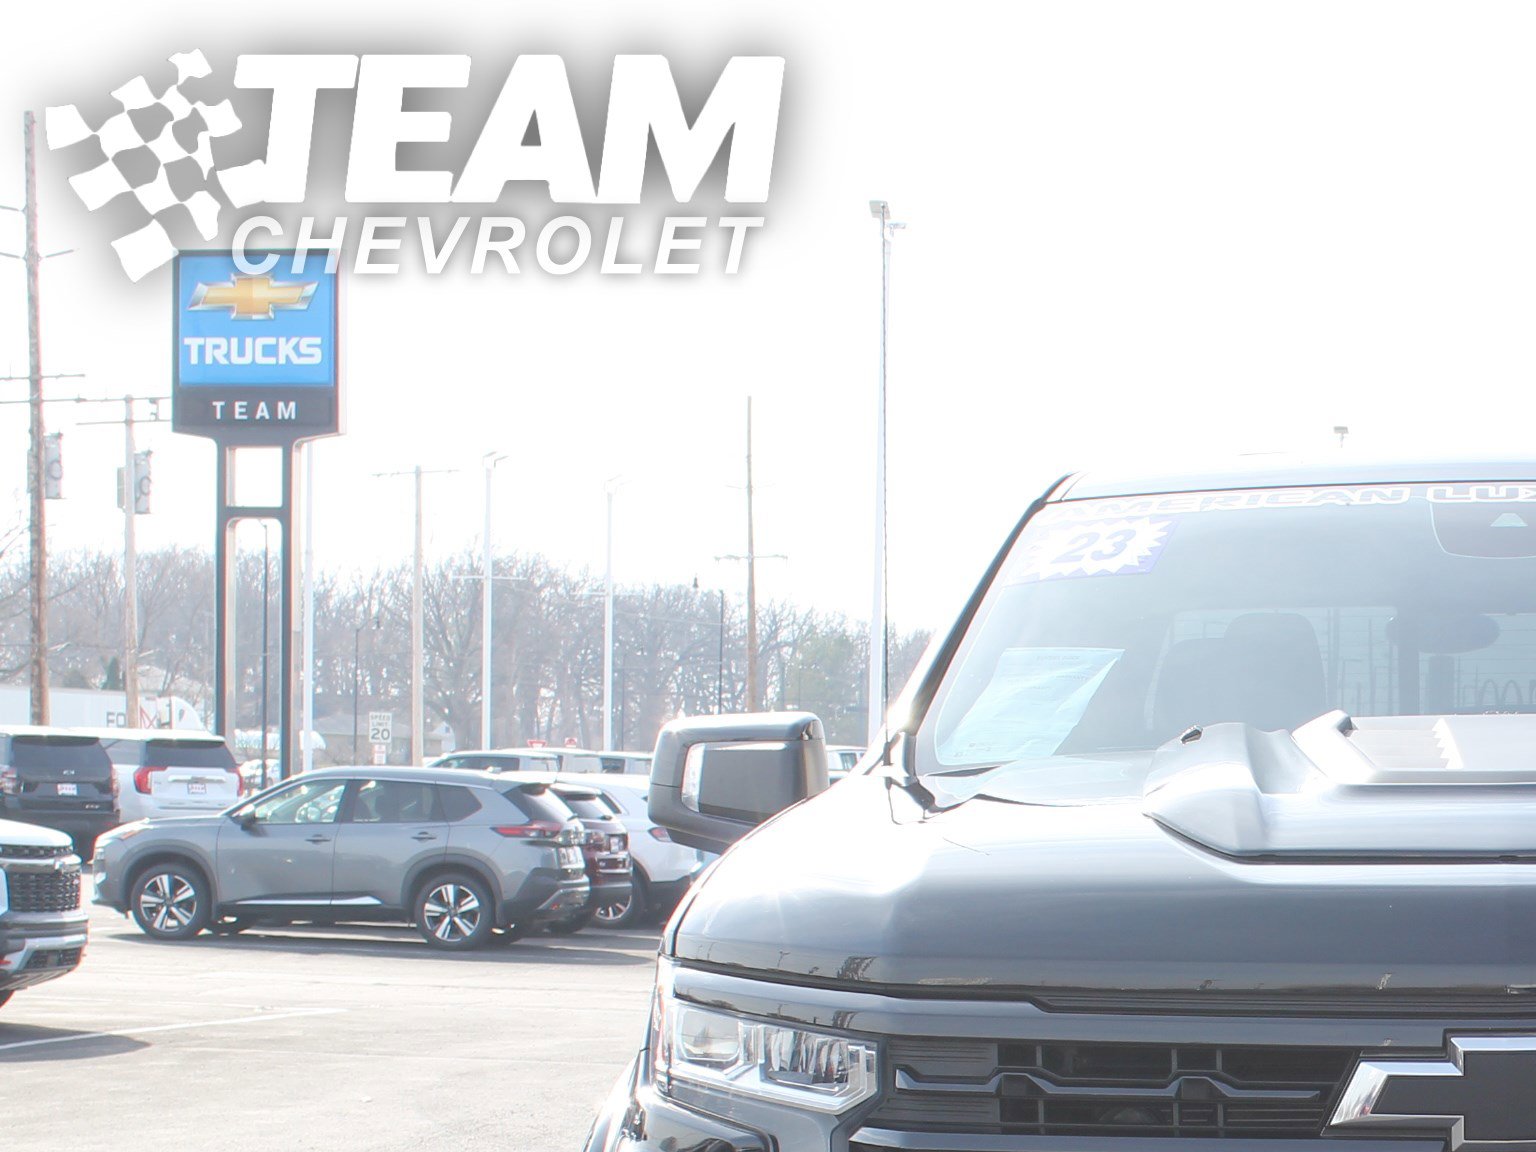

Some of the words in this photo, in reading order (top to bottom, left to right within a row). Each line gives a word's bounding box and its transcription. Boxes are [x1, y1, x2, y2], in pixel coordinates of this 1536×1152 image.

[184, 337, 322, 364] TRUCKS
[212, 402, 296, 420] TEAM
[1038, 487, 1410, 523] AMERICAN
[1050, 528, 1137, 564] 23
[371, 728, 391, 741] 20
